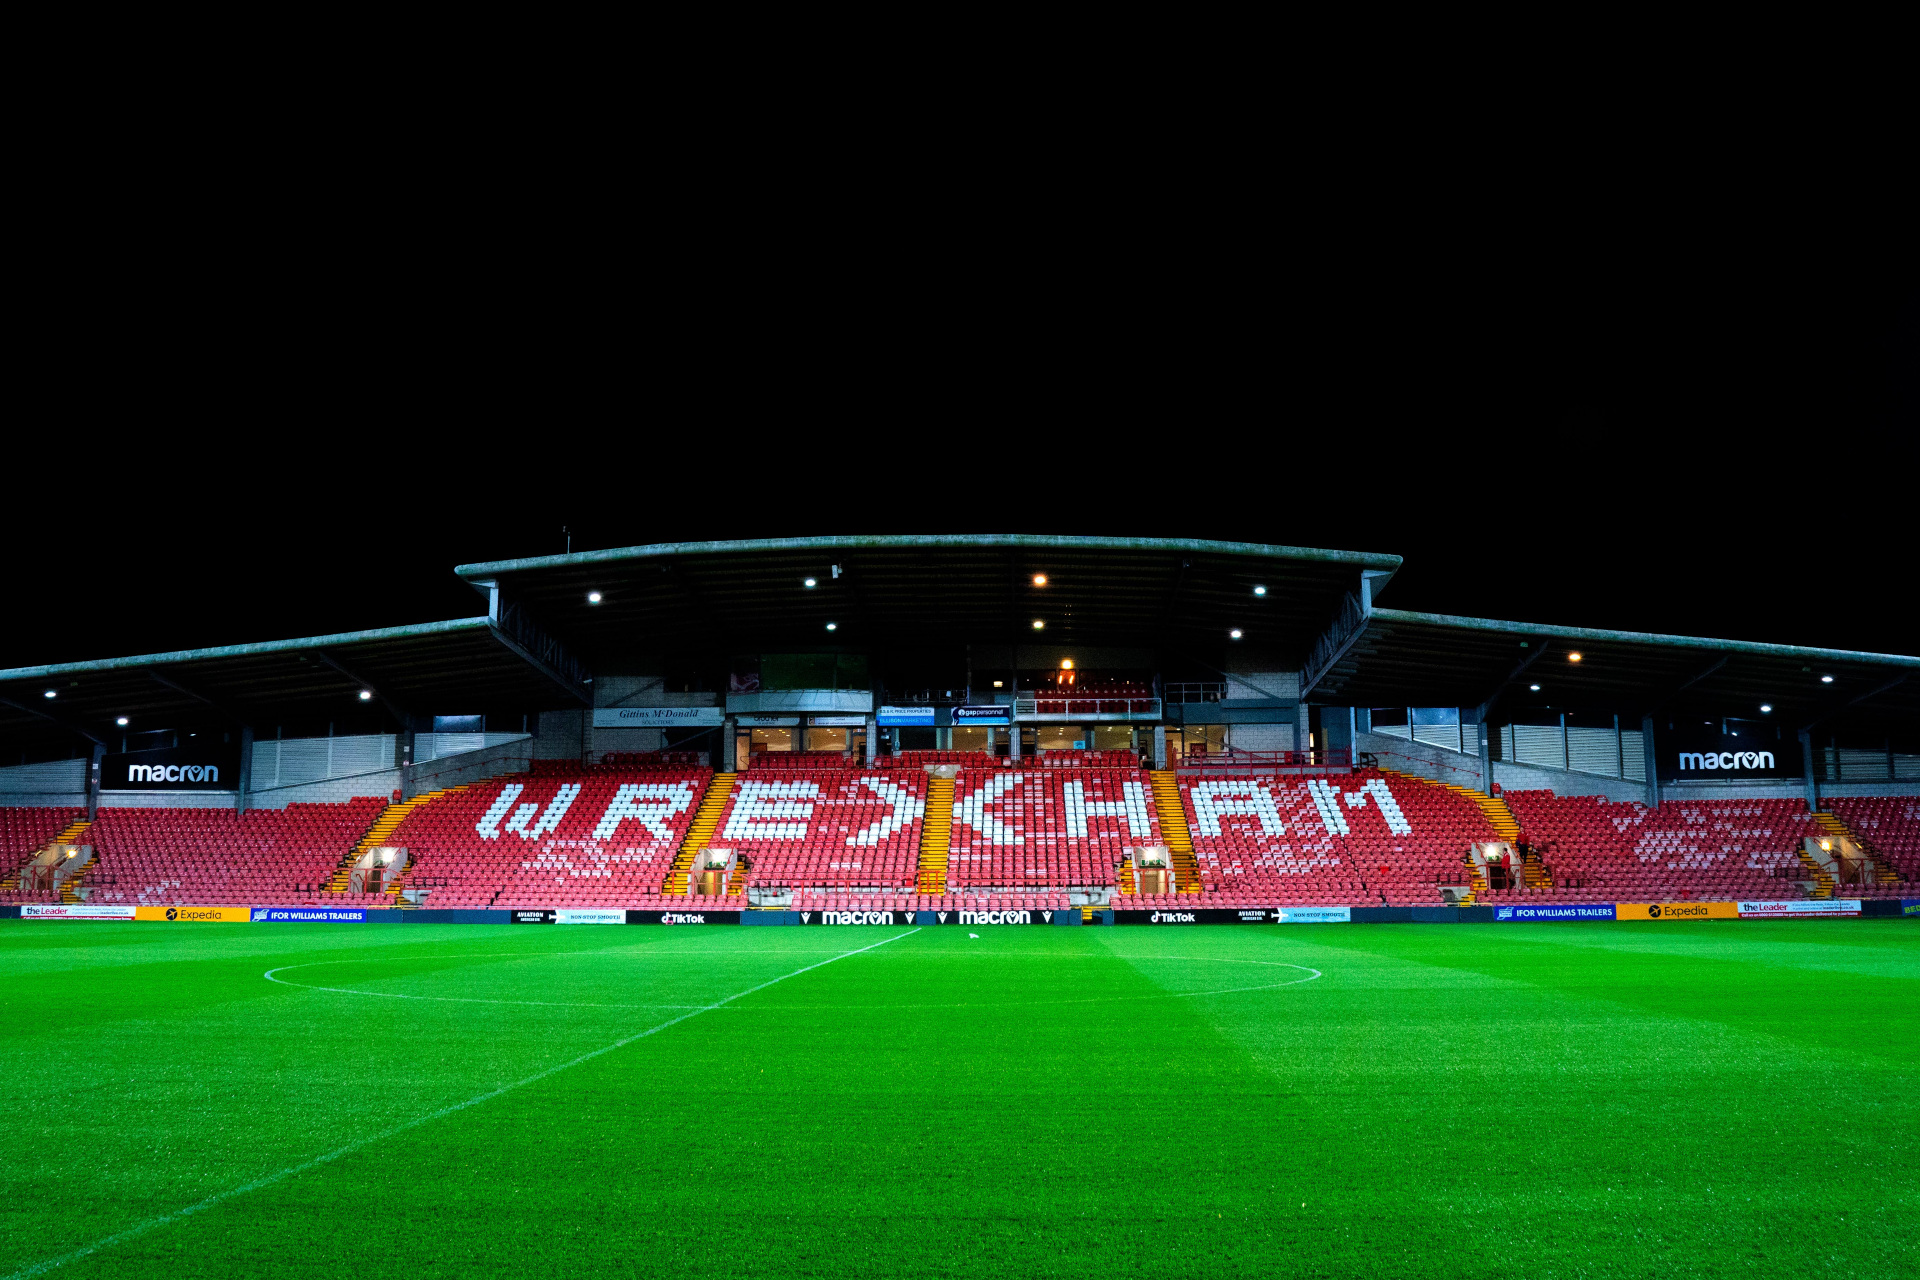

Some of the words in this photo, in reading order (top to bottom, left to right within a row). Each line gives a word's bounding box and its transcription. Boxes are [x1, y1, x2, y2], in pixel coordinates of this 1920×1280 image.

[619, 709, 650, 718] Gittins
[653, 709, 699, 718] McDonald
[1679, 751, 1775, 770] macron
[128, 764, 219, 782] macron
[26, 907, 40, 915] the
[41, 907, 68, 915] Leader
[1516, 909, 1535, 917] IFOR
[1536, 909, 1576, 917] WILLIAMS
[1577, 908, 1613, 916] TRAILERS
[1664, 905, 1708, 918] Expedia
[1743, 903, 1758, 911] the
[1759, 903, 1788, 911] Leader
[180, 909, 222, 921] Expedia
[271, 912, 289, 920] IFOR
[290, 912, 328, 920] WILLIAMS
[329, 912, 363, 920] TRAILERS
[671, 913, 705, 924] TikTok
[822, 911, 894, 925] macron
[958, 910, 1031, 925] macron
[1161, 912, 1196, 923] TikTok
